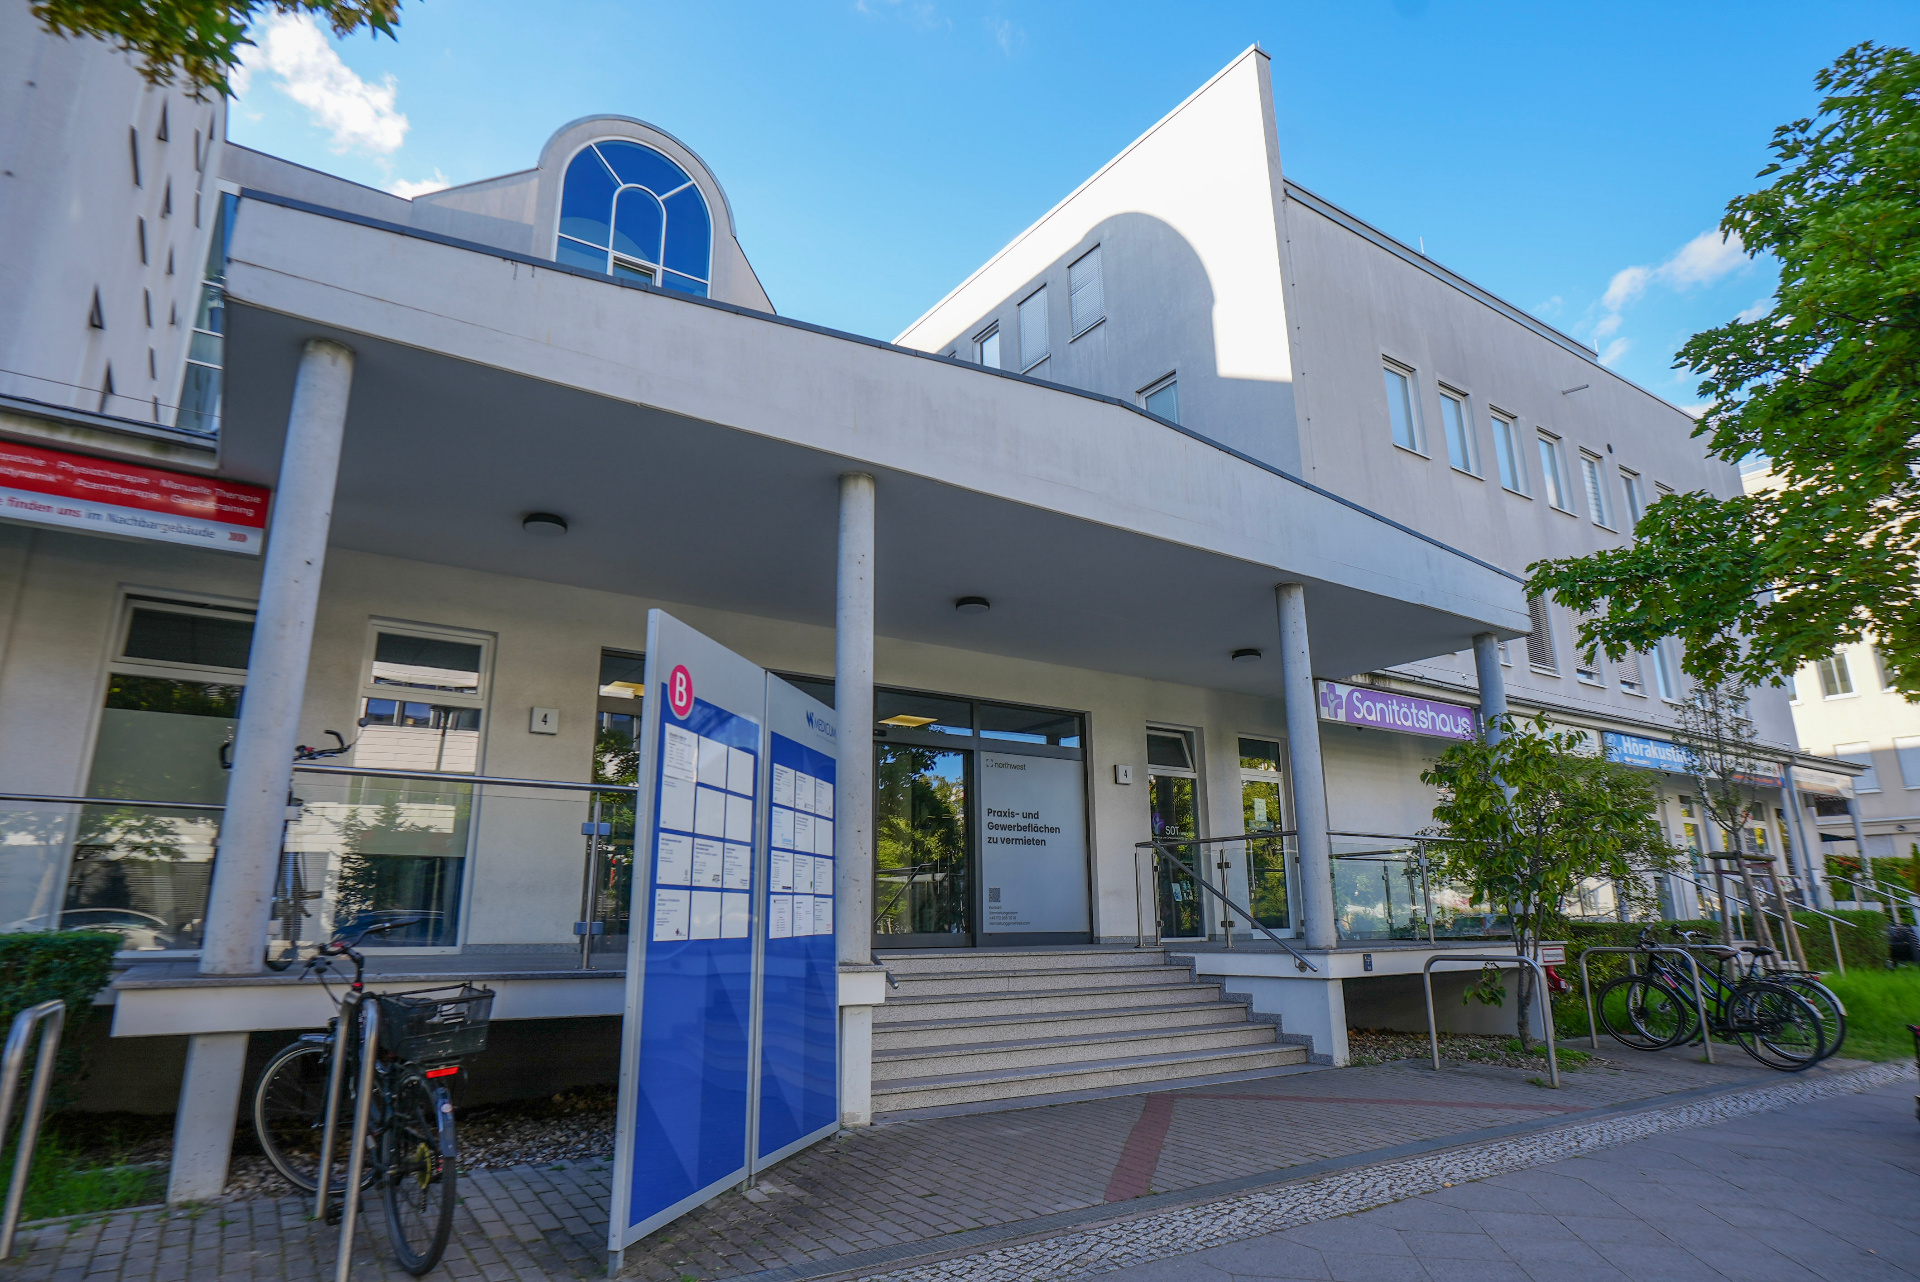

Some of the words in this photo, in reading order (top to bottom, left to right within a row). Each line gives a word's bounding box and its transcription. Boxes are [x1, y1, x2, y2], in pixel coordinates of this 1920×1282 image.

[56, 460, 150, 485] Physiotherapie
[160, 478, 212, 496] Manuelle
[214, 487, 262, 504] Therapie
[6, 496, 55, 514] finden
[56, 507, 83, 518] uns
[86, 508, 103, 521] im
[106, 512, 216, 539] Nachbargebäude
[675, 671, 688, 707] B
[541, 713, 548, 726] 4
[1352, 691, 1471, 736] Sanitätshaus
[994, 762, 1027, 771] northwest
[1123, 769, 1128, 779] 4
[987, 807, 1020, 819] Praxis-
[1022, 810, 1040, 820] und
[987, 821, 1061, 834] Gewerbeflächen
[1165, 825, 1180, 836] SOT
[987, 836, 998, 844] zu
[1000, 835, 1047, 846] vermieten
